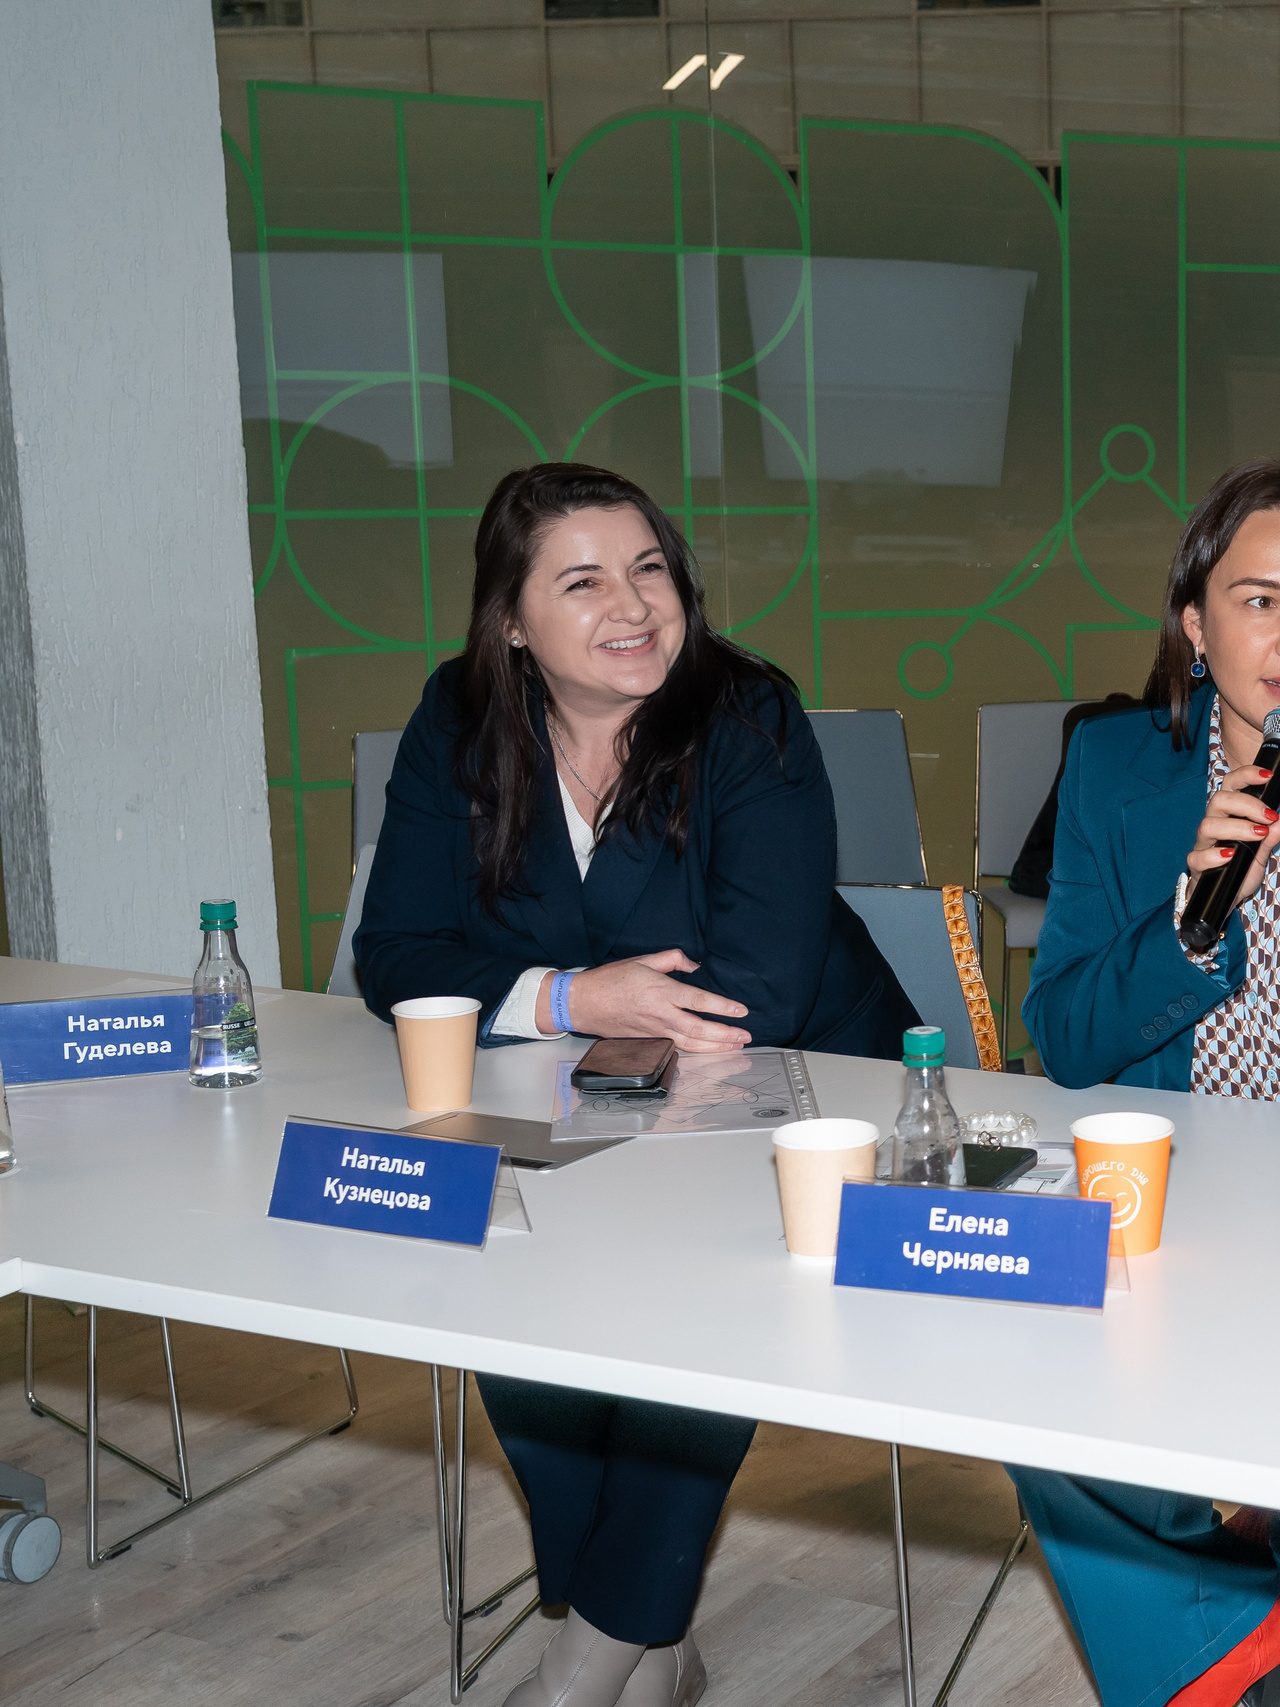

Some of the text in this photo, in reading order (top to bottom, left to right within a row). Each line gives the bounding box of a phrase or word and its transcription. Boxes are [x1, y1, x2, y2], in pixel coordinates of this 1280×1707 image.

[67, 1014, 165, 1033] Наталья
[63, 1040, 172, 1064] Гуделева
[341, 1146, 426, 1177] Наталья
[1081, 1160, 1150, 1187] ХОРОШЕГО ДНЯ
[323, 1176, 432, 1211] Кузнецова
[928, 1206, 1010, 1237] Елена
[902, 1241, 1031, 1275] Черняева
